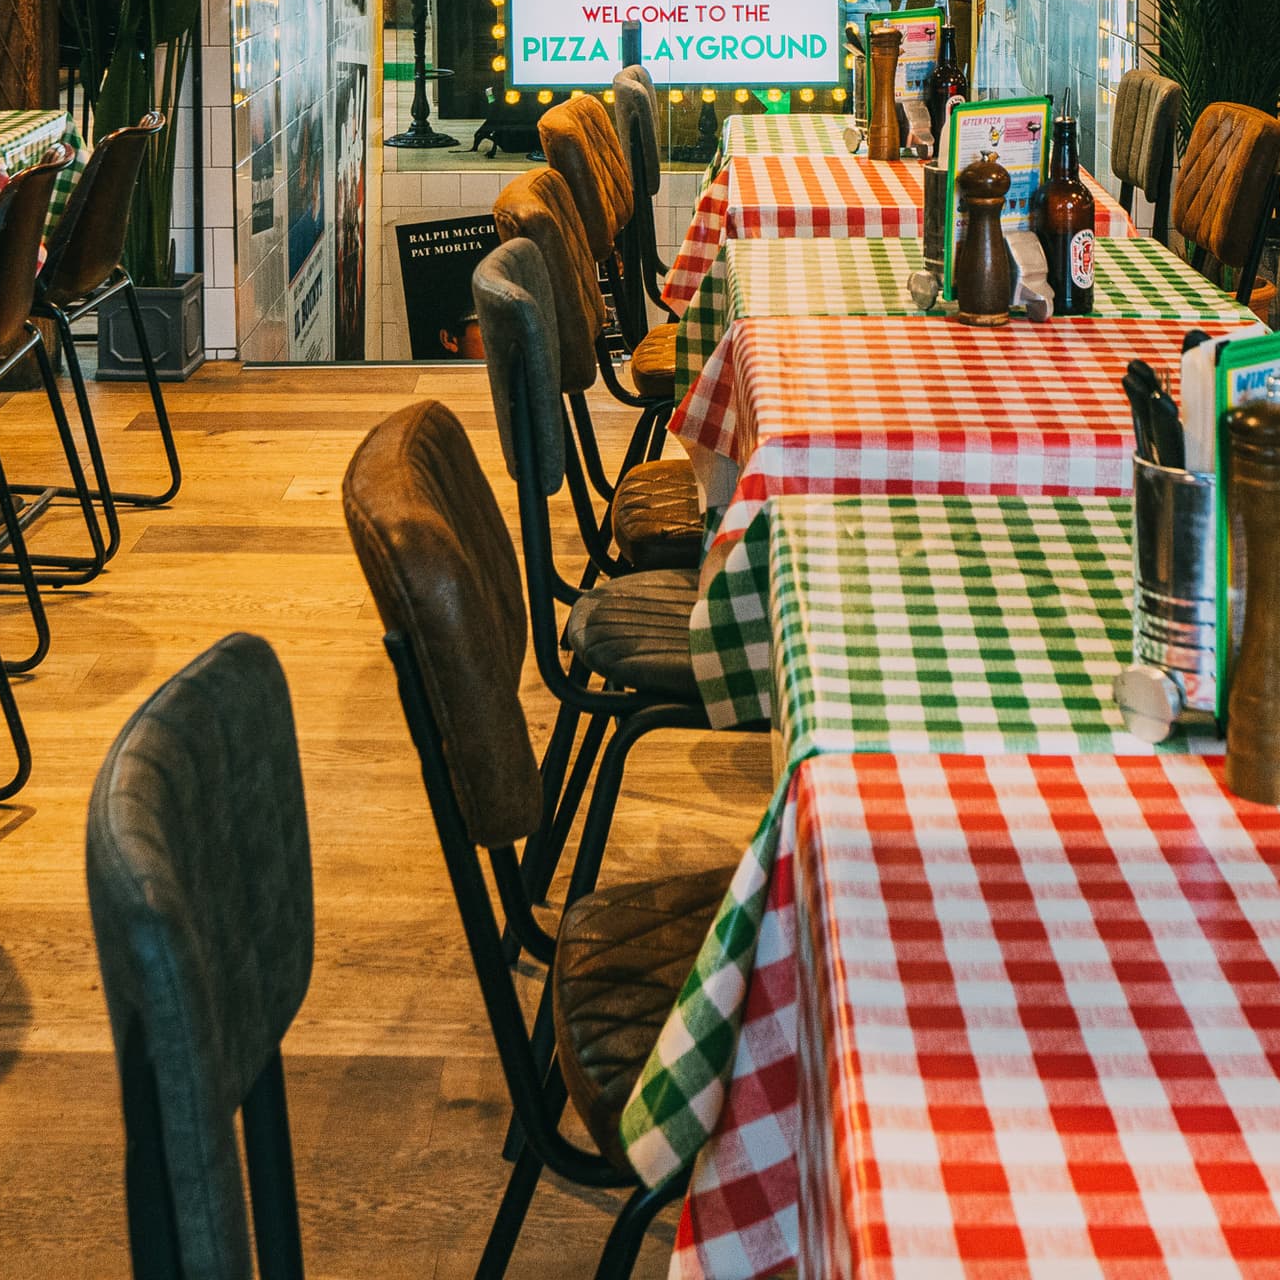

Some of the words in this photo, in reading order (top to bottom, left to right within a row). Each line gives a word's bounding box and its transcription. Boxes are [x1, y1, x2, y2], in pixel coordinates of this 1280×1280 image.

[582, 4, 689, 24] WELCOME
[696, 4, 726, 23] TO
[732, 4, 771, 22] THE
[523, 36, 608, 62] PIZZA
[617, 34, 827, 61] AYGROUND
[409, 230, 449, 244] RALPH
[453, 224, 495, 238] MACCH
[411, 247, 432, 258] PAT
[434, 241, 483, 256] MORITA
